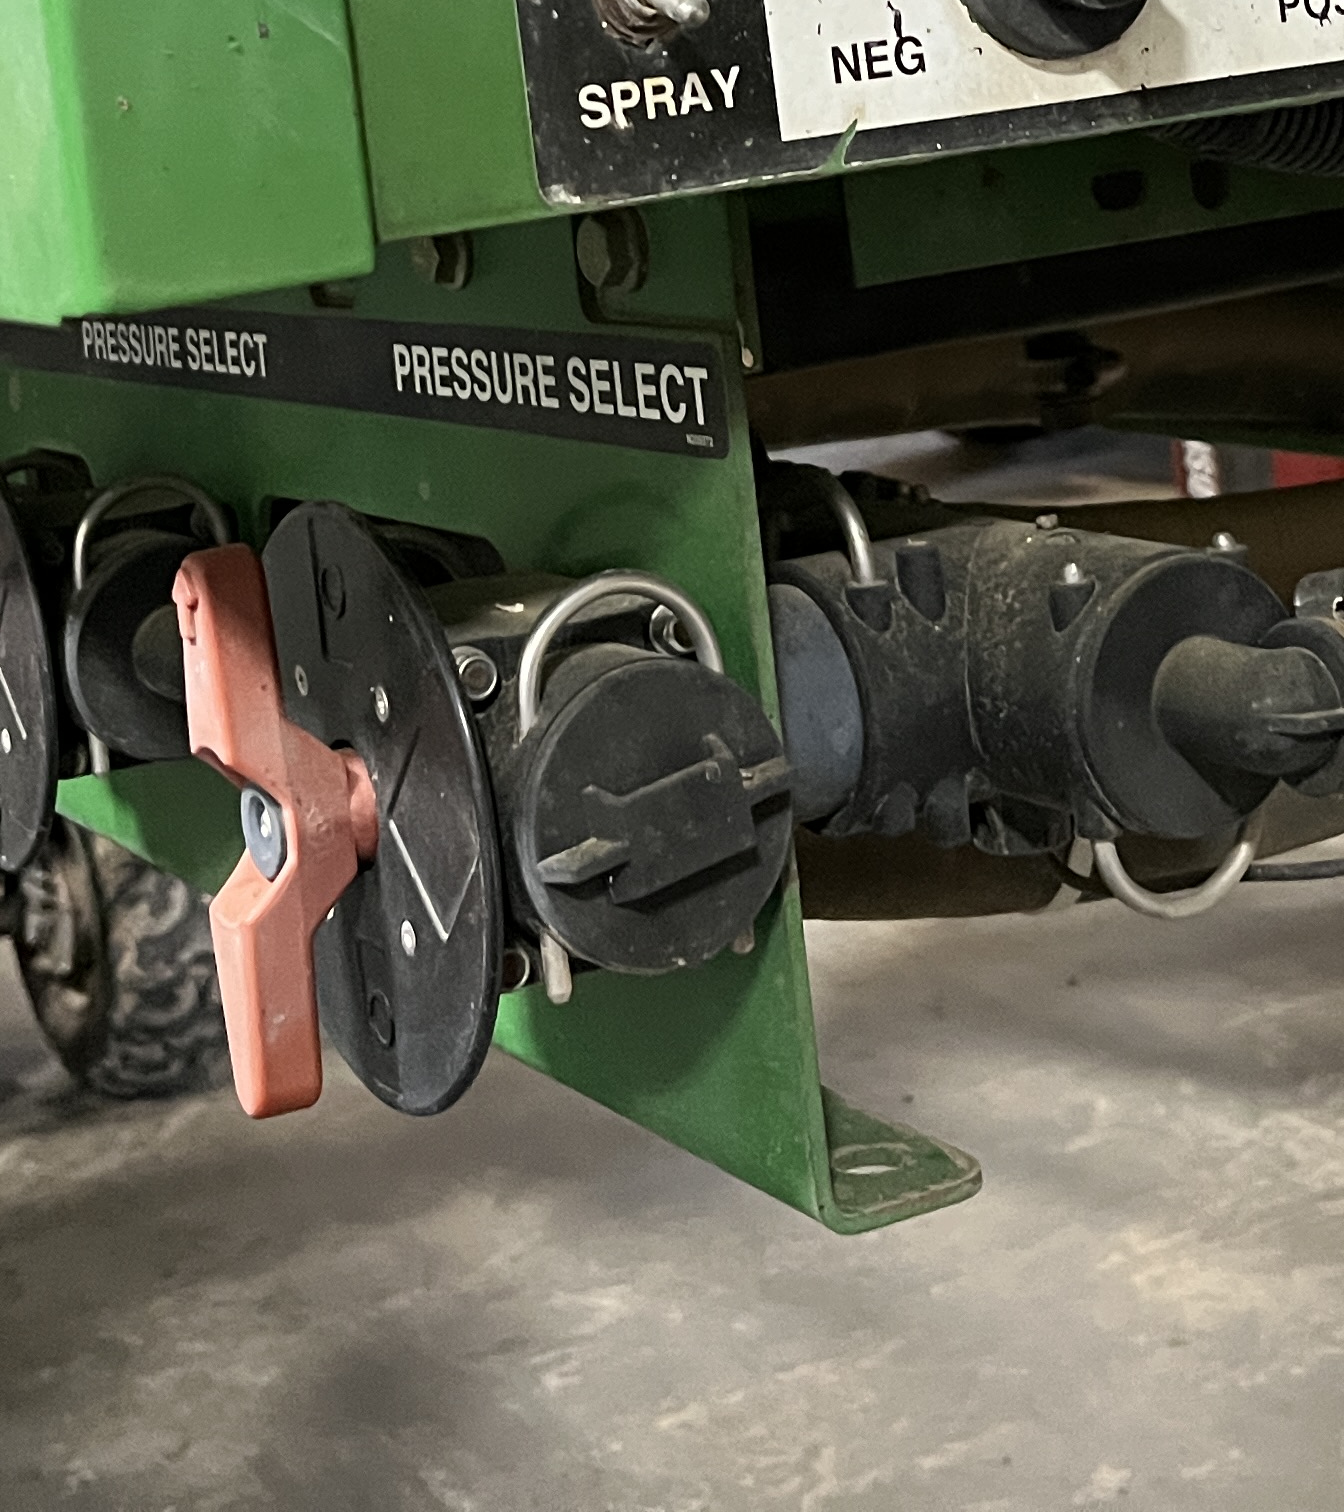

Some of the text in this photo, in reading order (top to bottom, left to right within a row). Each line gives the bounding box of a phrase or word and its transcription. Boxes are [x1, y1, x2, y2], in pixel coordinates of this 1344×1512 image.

[831, 36, 927, 85] NEG
[578, 65, 740, 129] SPRAY
[81, 320, 268, 378] PRESSURE SELECT
[393, 343, 709, 426] PRESSURE SELECT
